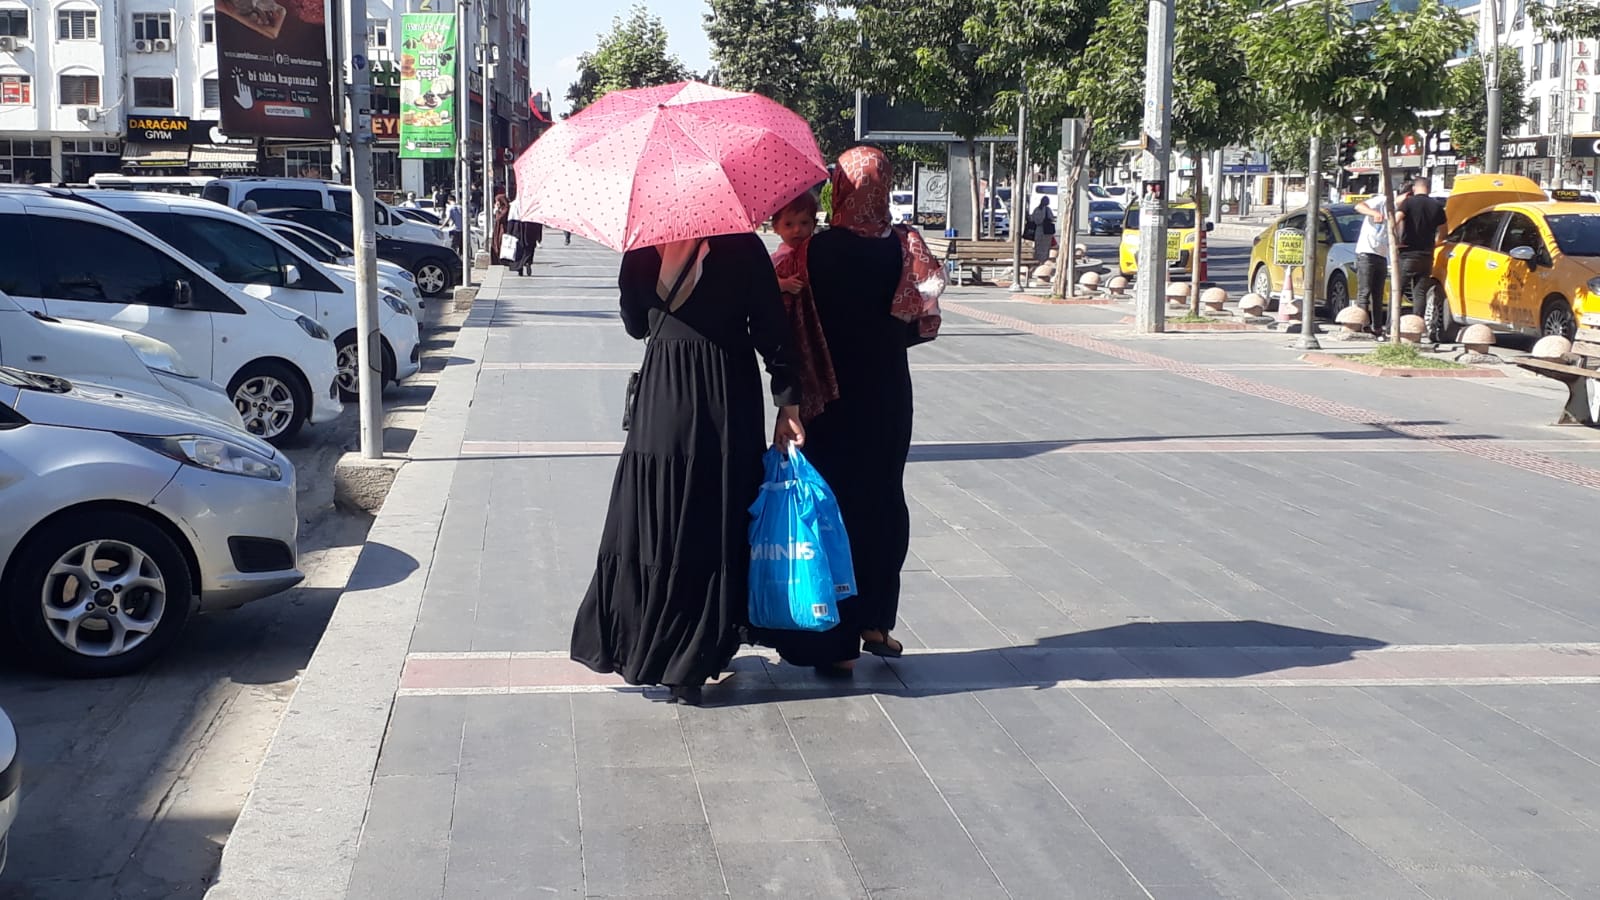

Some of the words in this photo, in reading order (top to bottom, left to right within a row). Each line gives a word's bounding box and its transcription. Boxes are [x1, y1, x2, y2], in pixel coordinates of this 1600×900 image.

[419, 54, 437, 66] bol
[247, 70, 257, 81] bi
[259, 71, 277, 83] tıkla
[416, 67, 440, 80] çeşit
[129, 118, 188, 130] DARAĞAN
